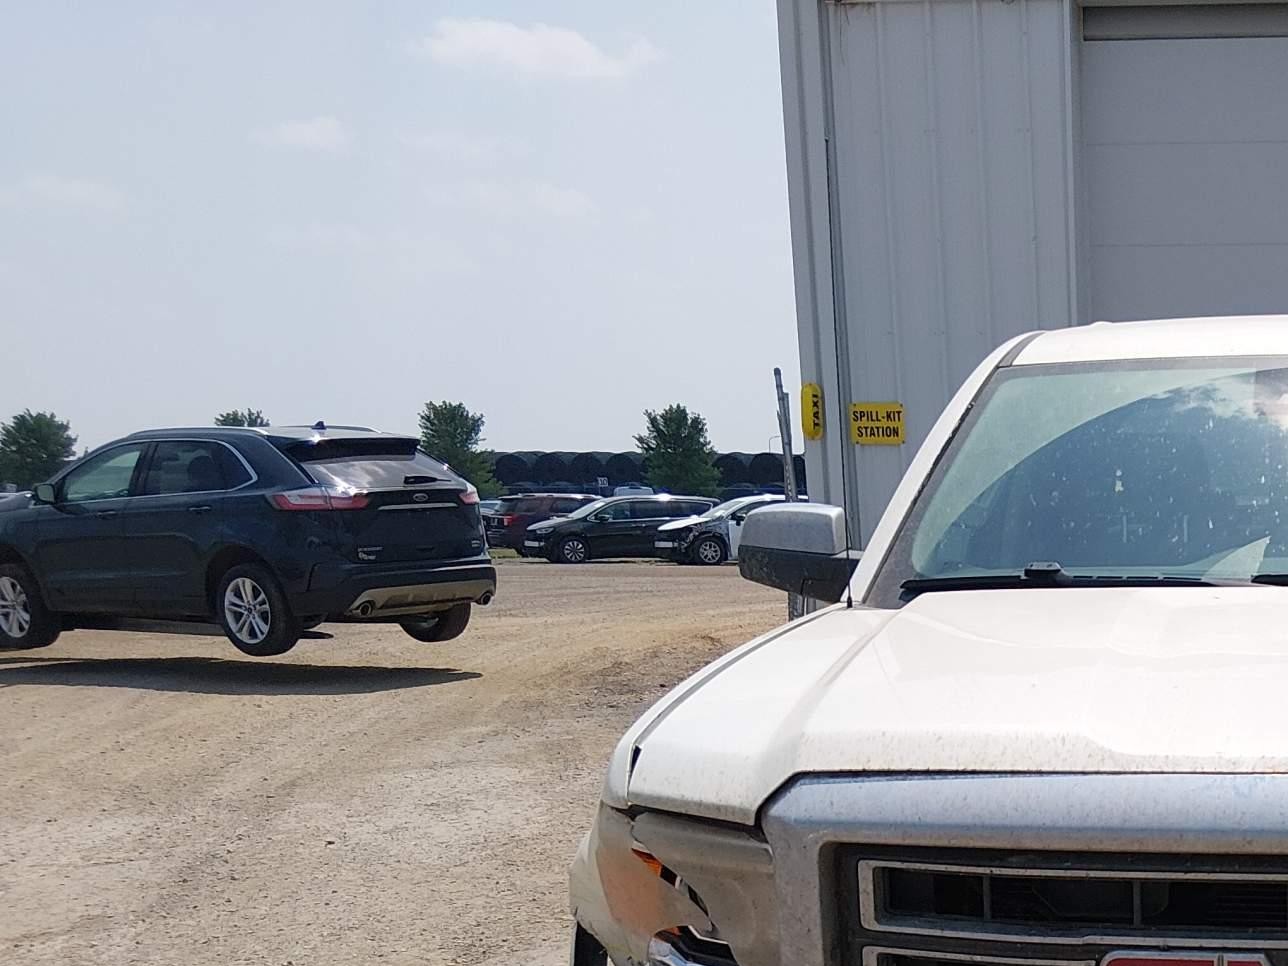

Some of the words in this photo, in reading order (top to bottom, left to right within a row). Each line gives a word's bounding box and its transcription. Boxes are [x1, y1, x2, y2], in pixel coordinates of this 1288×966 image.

[812, 393, 821, 430] TAXI
[852, 410, 902, 422] SPILL-KIT
[857, 426, 899, 438] STATION
